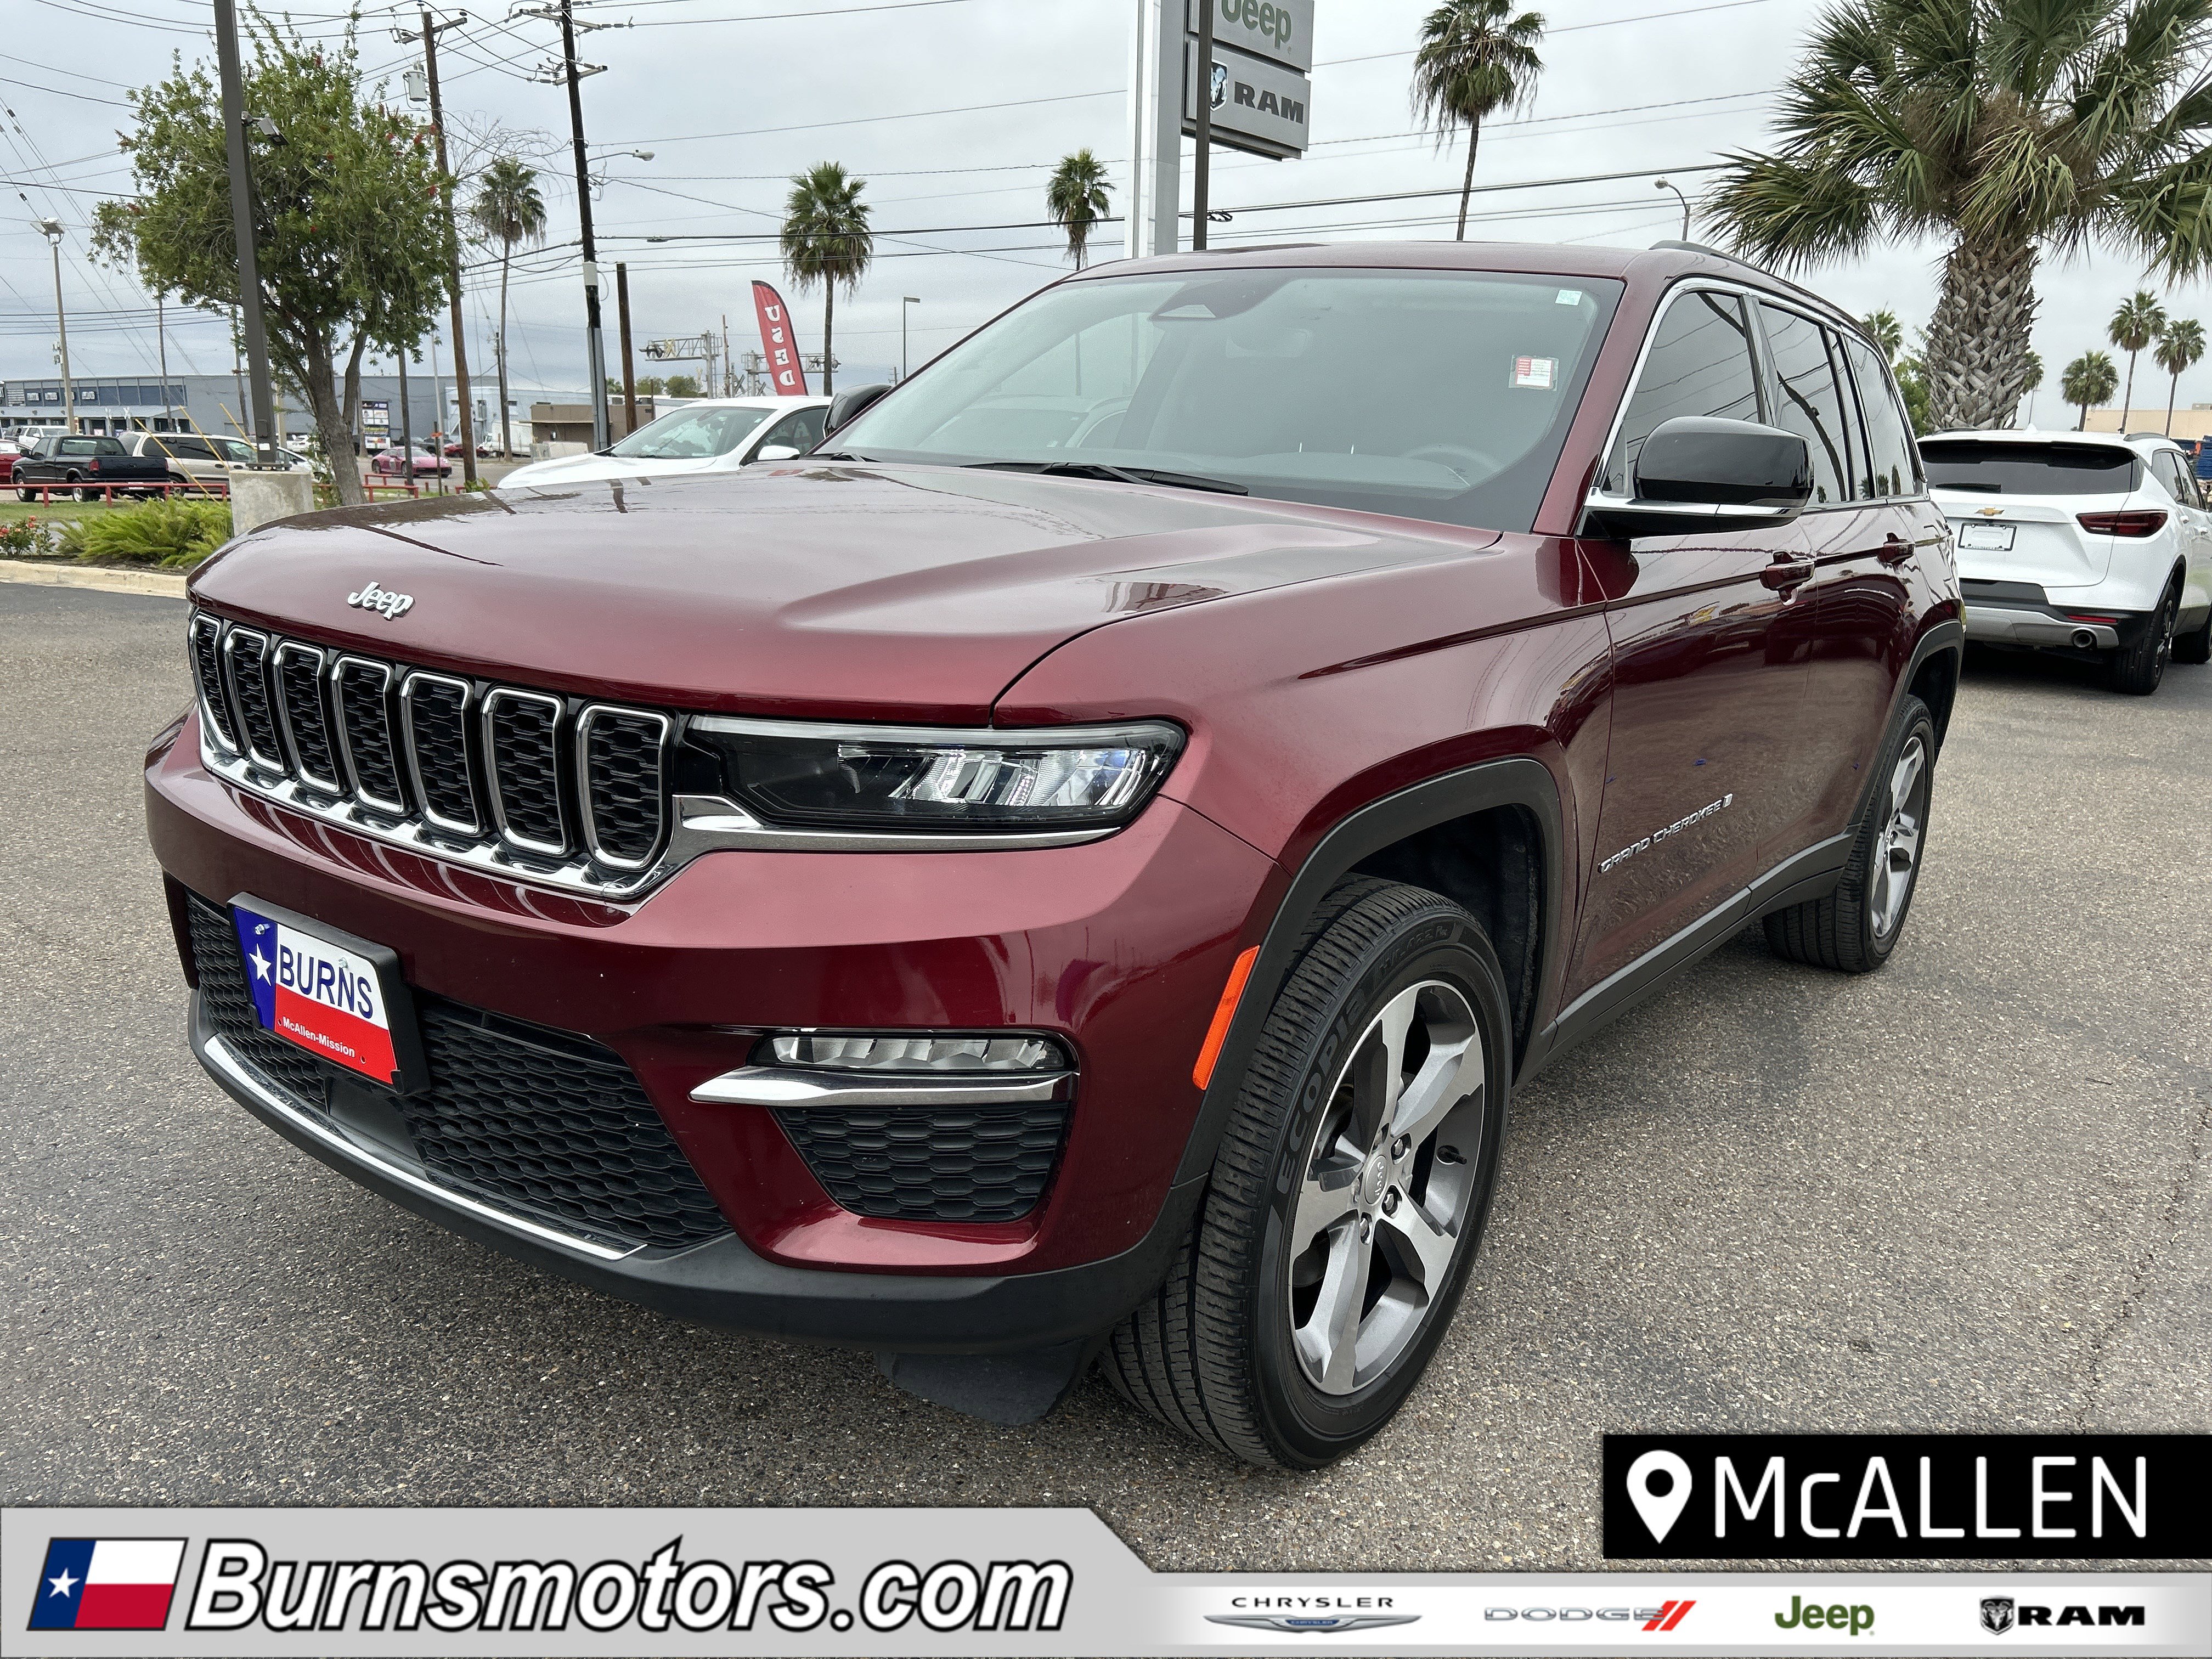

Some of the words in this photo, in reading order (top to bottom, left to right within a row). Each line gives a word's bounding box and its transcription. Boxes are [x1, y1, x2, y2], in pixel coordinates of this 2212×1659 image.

[1234, 81, 1304, 124] RAM
[347, 581, 415, 621] Jeep
[1598, 837, 1650, 873] GRAND
[1651, 799, 1723, 844] CHEROKEE
[280, 944, 374, 1019] BURNS
[283, 1016, 356, 1058] McAllen-Mission
[1277, 986, 1366, 1194] ECOPIA
